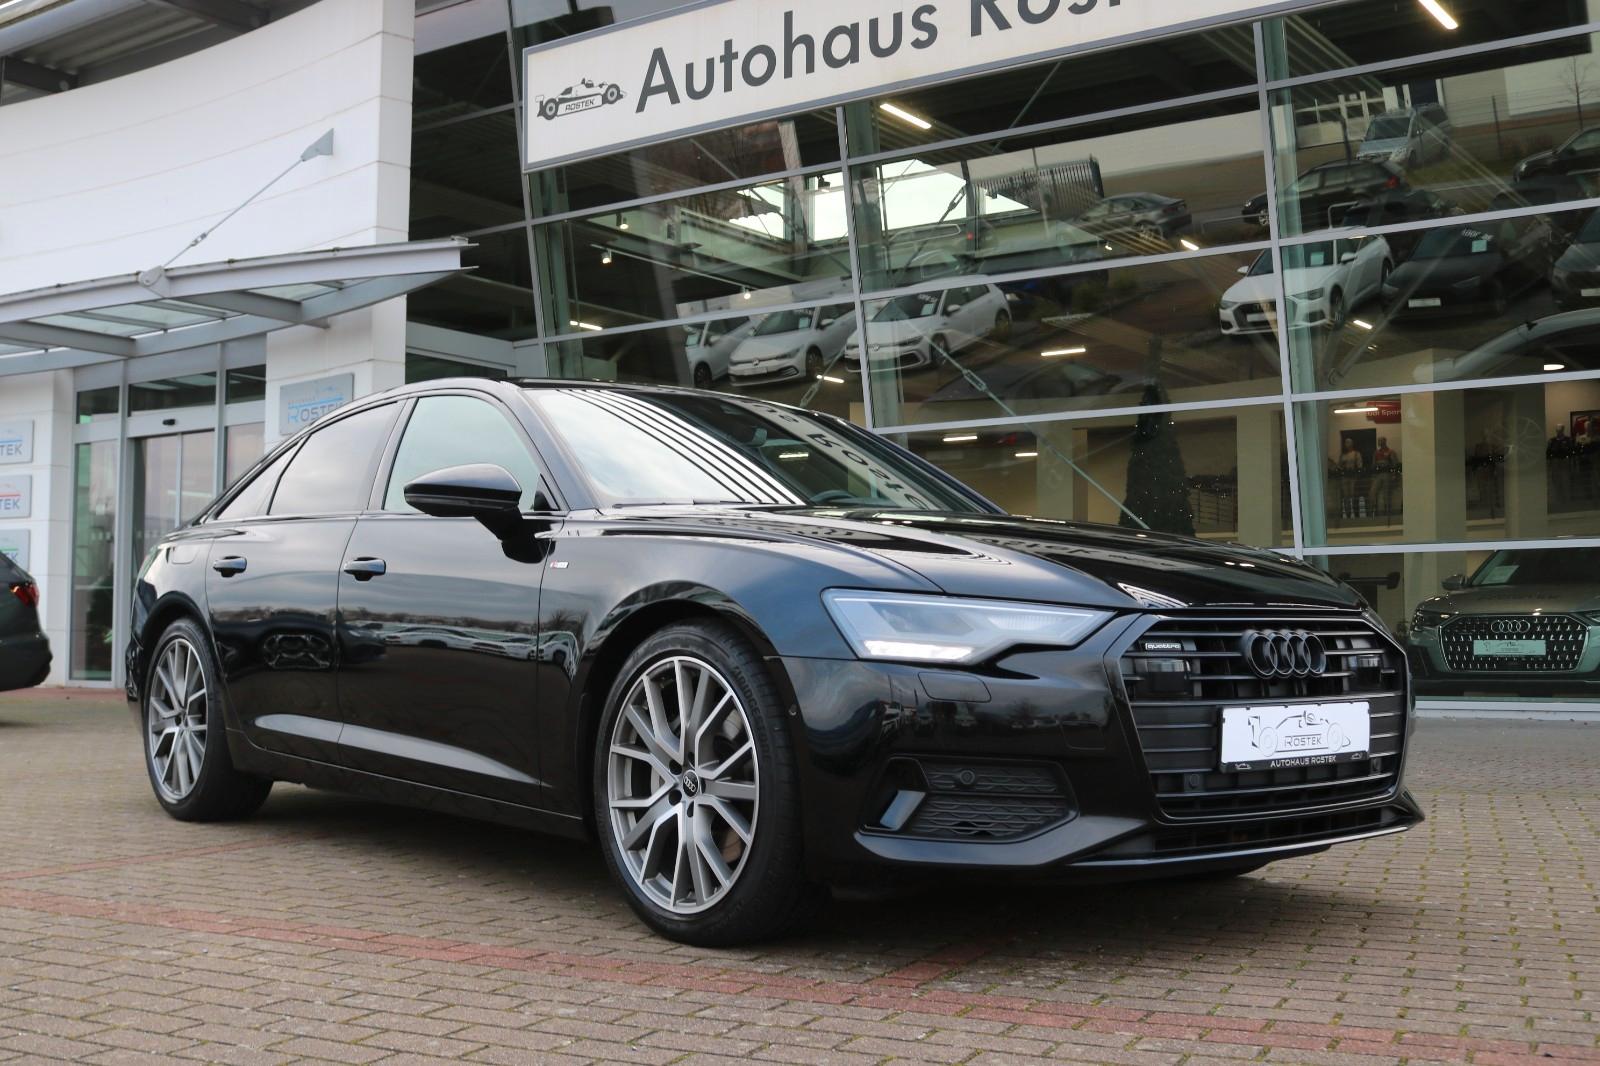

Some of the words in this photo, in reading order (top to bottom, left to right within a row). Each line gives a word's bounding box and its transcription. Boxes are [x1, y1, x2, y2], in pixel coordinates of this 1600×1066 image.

[634, 4, 938, 113] Autohaus
[565, 98, 595, 112] ROSTEK
[1284, 734, 1323, 748] ROSTEK
[1270, 757, 1310, 768] AUTOHAUS
[1311, 755, 1336, 765] ROSTEK
